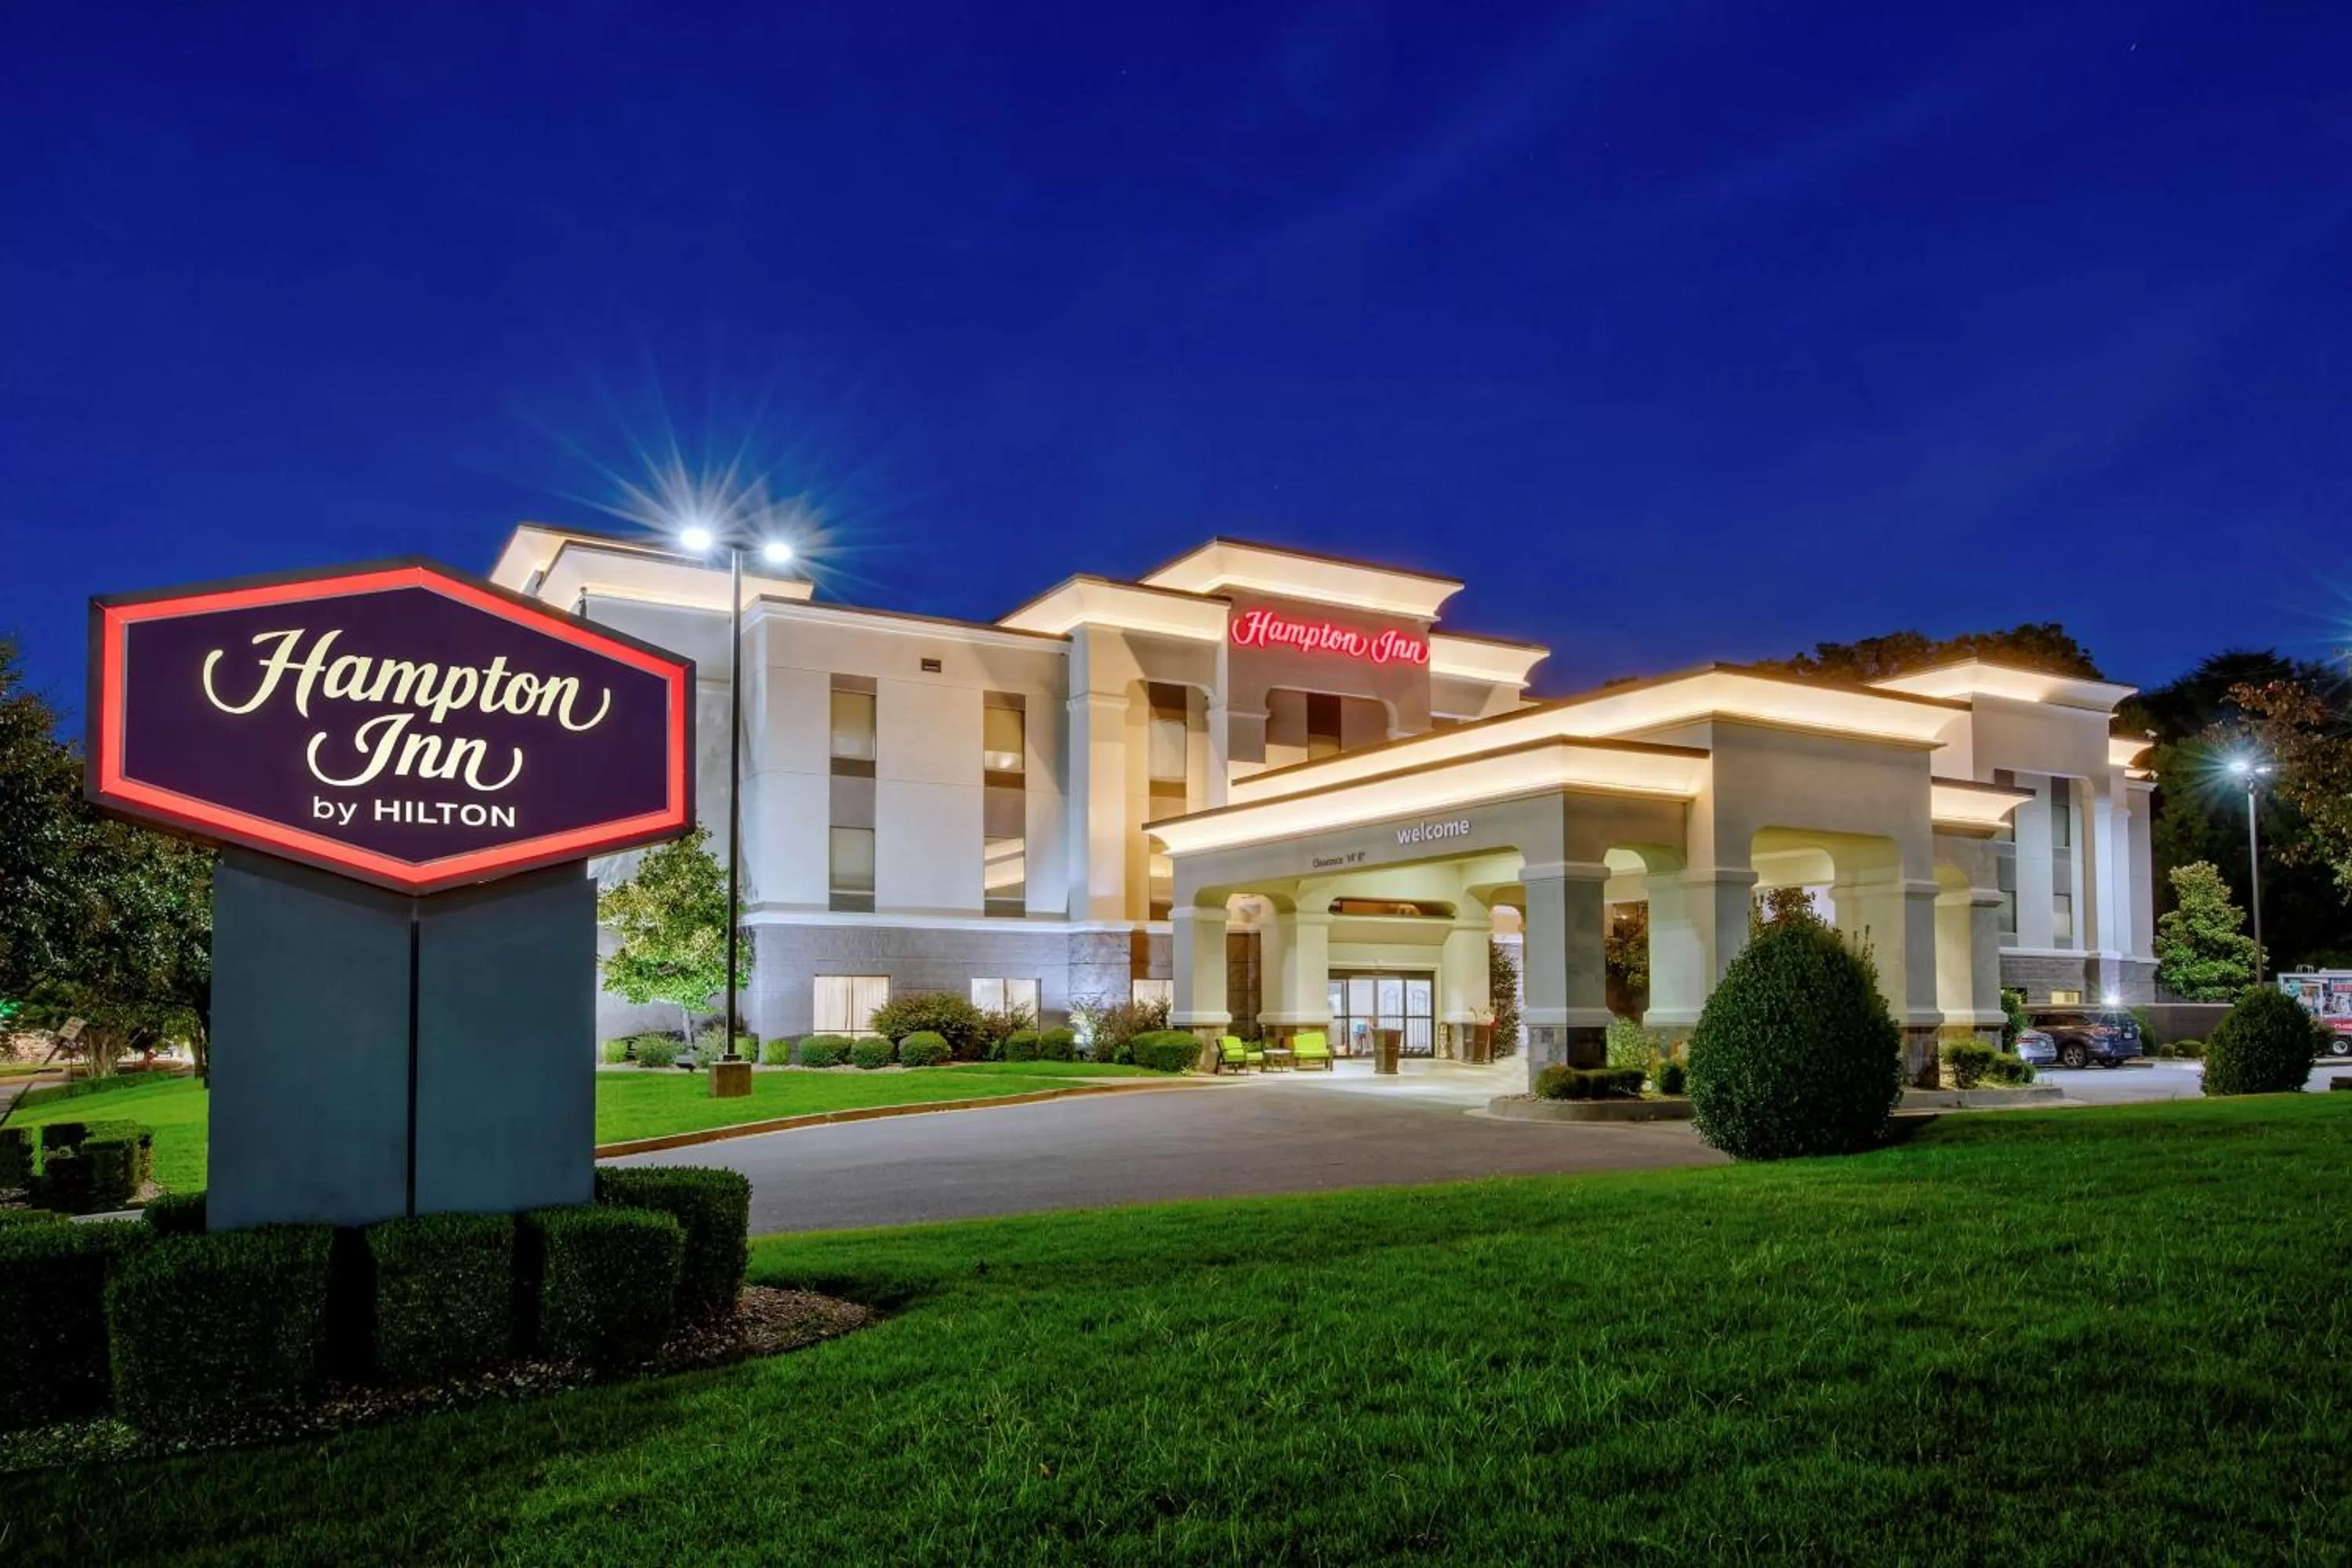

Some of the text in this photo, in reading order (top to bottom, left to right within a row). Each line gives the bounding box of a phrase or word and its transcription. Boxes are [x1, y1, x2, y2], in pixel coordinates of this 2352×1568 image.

[1232, 611, 1431, 664] Hampton Inn
[202, 627, 611, 732] Hampton
[307, 713, 523, 791] Inn
[313, 795, 516, 828] by HILTON
[1396, 818, 1471, 844] welcome
